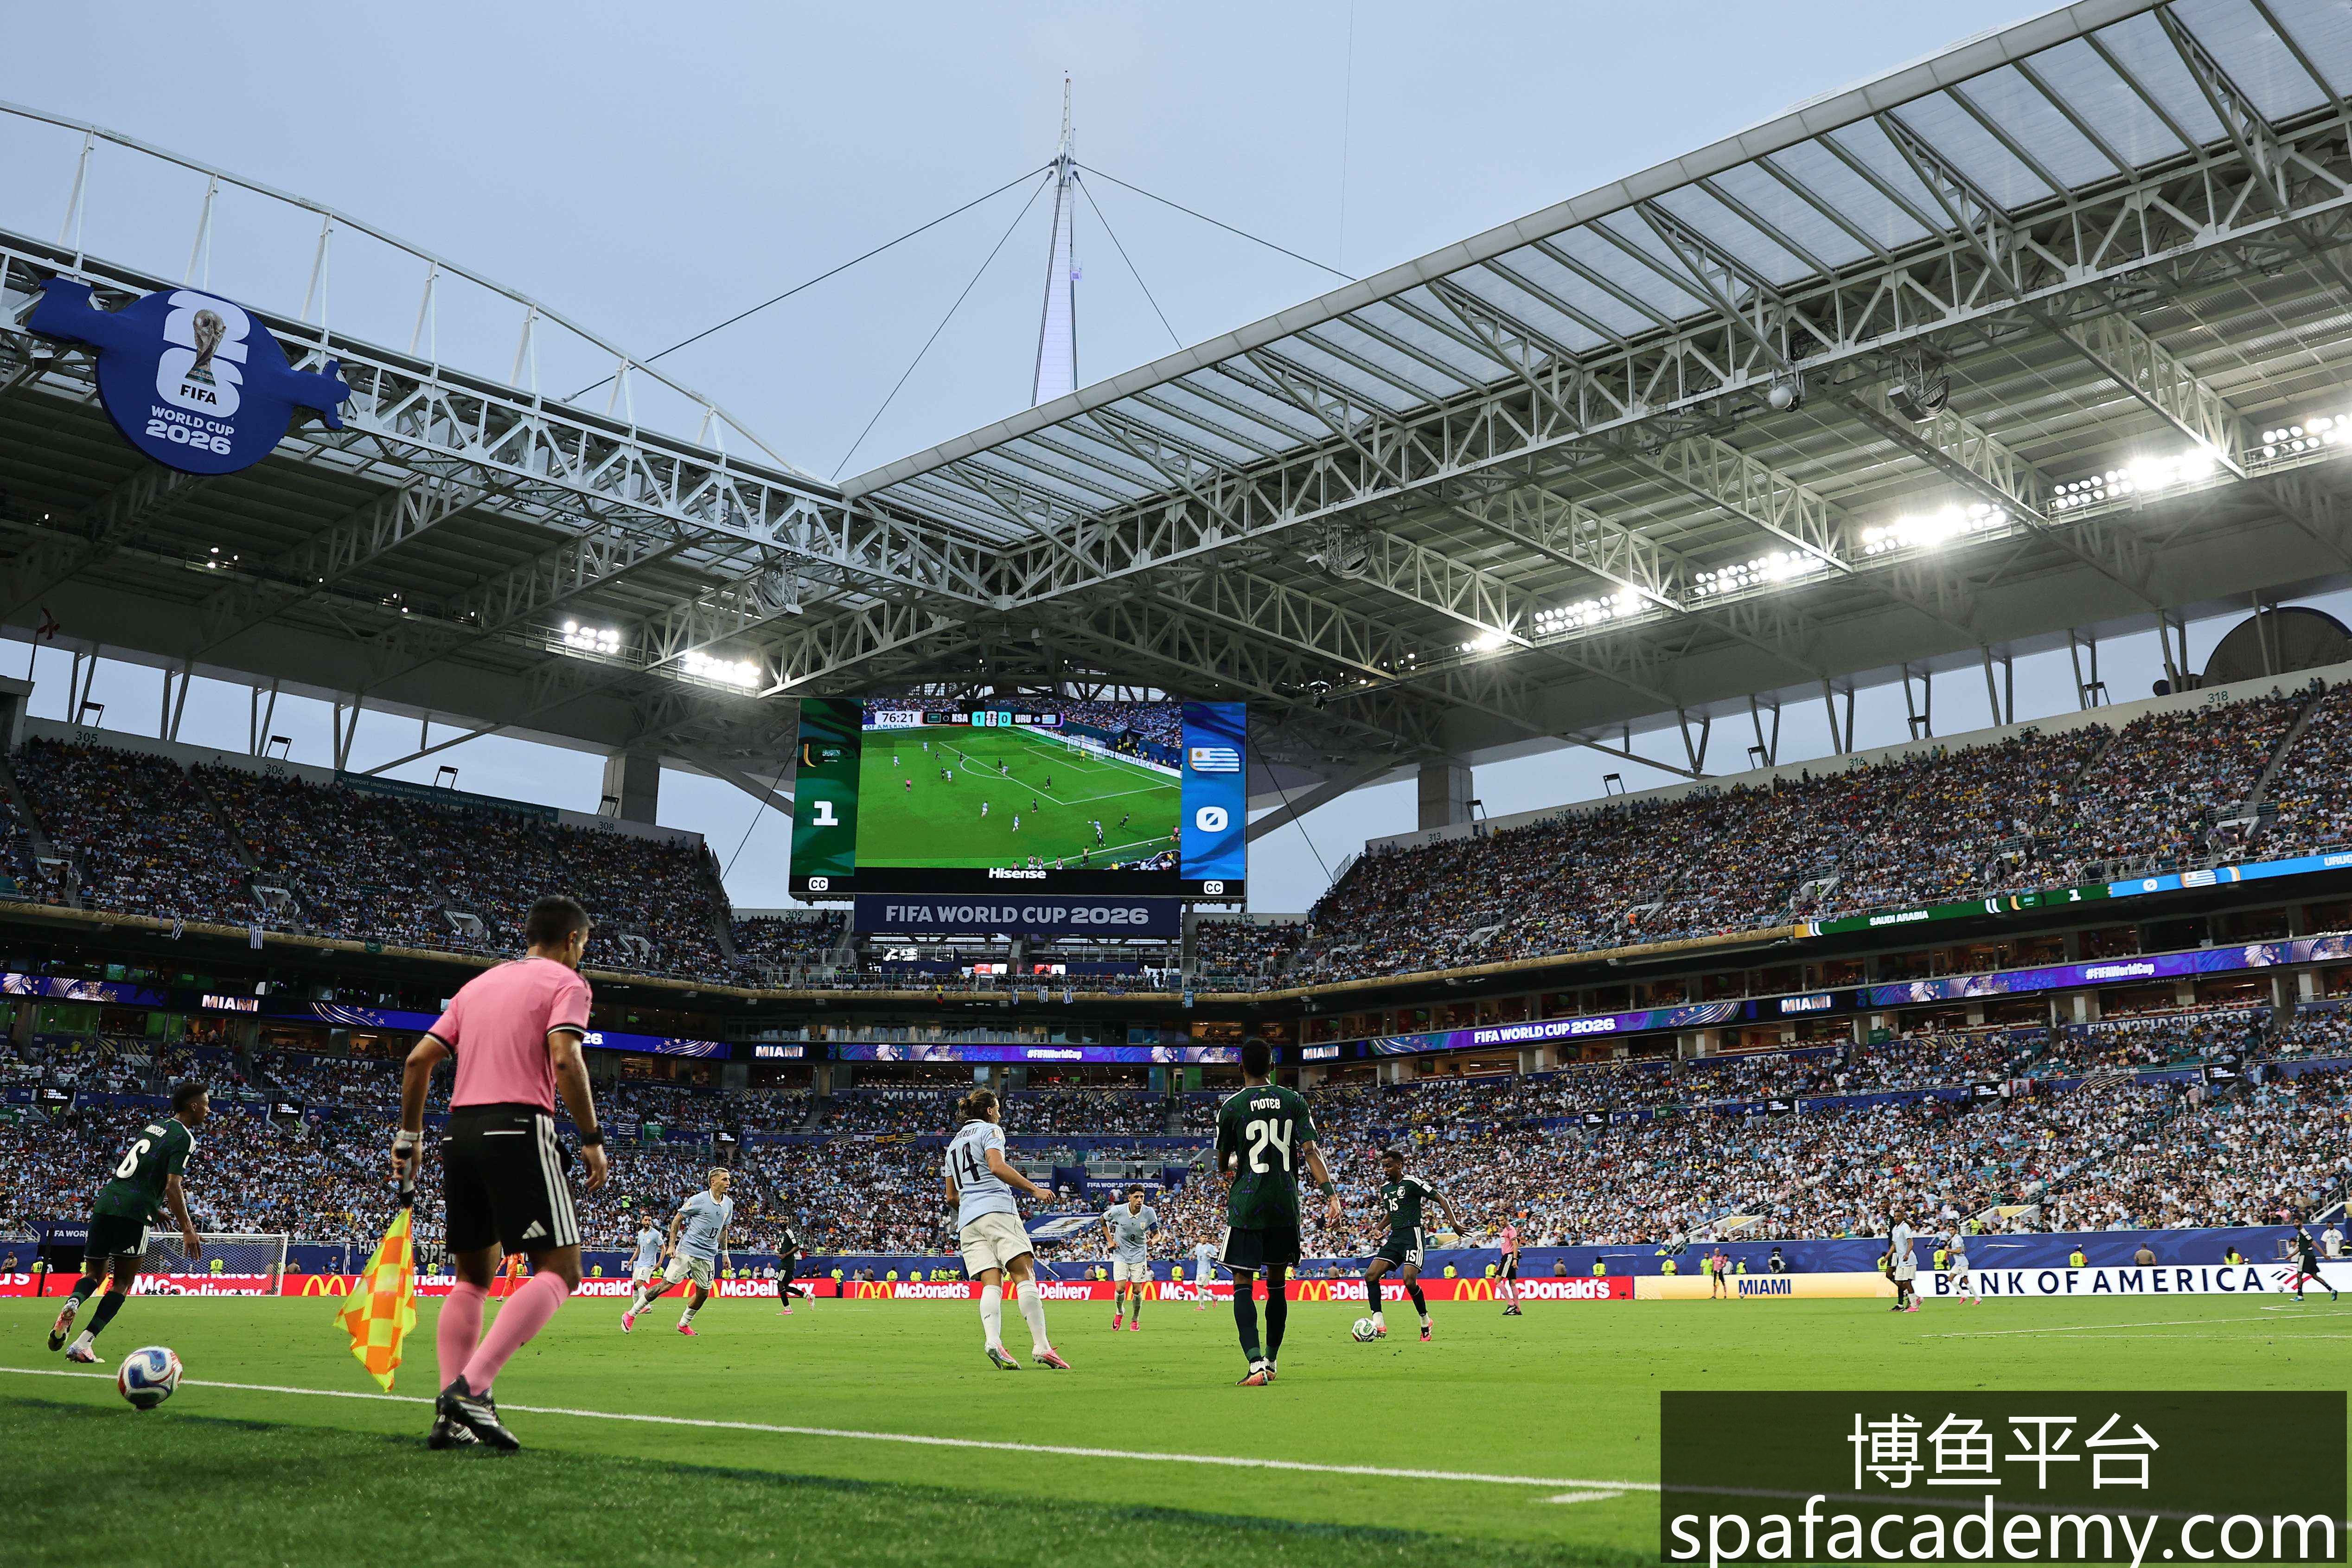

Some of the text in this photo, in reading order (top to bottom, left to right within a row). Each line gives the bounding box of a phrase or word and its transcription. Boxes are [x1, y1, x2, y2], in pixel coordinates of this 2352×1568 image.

[180, 384, 217, 405] FIFA
[151, 405, 235, 436] WORLD CUP
[145, 419, 231, 455] 2026
[2207, 691, 2229, 704] 318
[882, 713, 1031, 723] 76:21 KSA 1 0 URU
[76, 730, 98, 744] 305
[1848, 756, 1865, 768] 316
[265, 763, 284, 776] 306
[404, 787, 431, 796] BEHAVIOR
[1694, 785, 1709, 795] 315
[813, 801, 838, 826] 1
[1195, 806, 1228, 833] 0
[598, 821, 615, 832] 308
[1428, 832, 1441, 842] 313
[988, 867, 1047, 879] Hisense
[811, 880, 826, 889] CC
[1206, 883, 1221, 892] CC
[2069, 889, 2082, 902] 1
[786, 910, 804, 920] 309
[886, 906, 1149, 925] FIFA WORLD CUP 2026
[1869, 910, 1929, 926] SAUDI ARABIA
[2085, 962, 2155, 979] #FIFAWorldCup
[202, 994, 258, 1012] MIAMI
[1781, 994, 1831, 1013] MIAMI
[1474, 1018, 1616, 1043] FIFA WORLD CUP 2026
[755, 1045, 804, 1058] MIAMI
[1027, 1049, 1082, 1060] #FIFAWorldCup
[1303, 1045, 1339, 1060] MIAMI
[1250, 1098, 1281, 1112] MOTEB
[1246, 1118, 1293, 1174] 24
[116, 1139, 151, 1178] 6
[950, 1141, 981, 1190] 14
[1388, 1197, 1399, 1211] 15
[709, 1227, 718, 1239] 13
[1406, 1249, 1417, 1262] 15
[707, 1270, 715, 1282] 13
[1142, 1265, 1146, 1275] 8
[1738, 1279, 1792, 1295] MIAMI
[2038, 1271, 2079, 1294] OF
[2093, 1267, 2265, 1293] AMERICA
[572, 1280, 635, 1297] Donald'
[894, 1282, 971, 1299] McDonald's
[1037, 1284, 1093, 1300] Delivery
